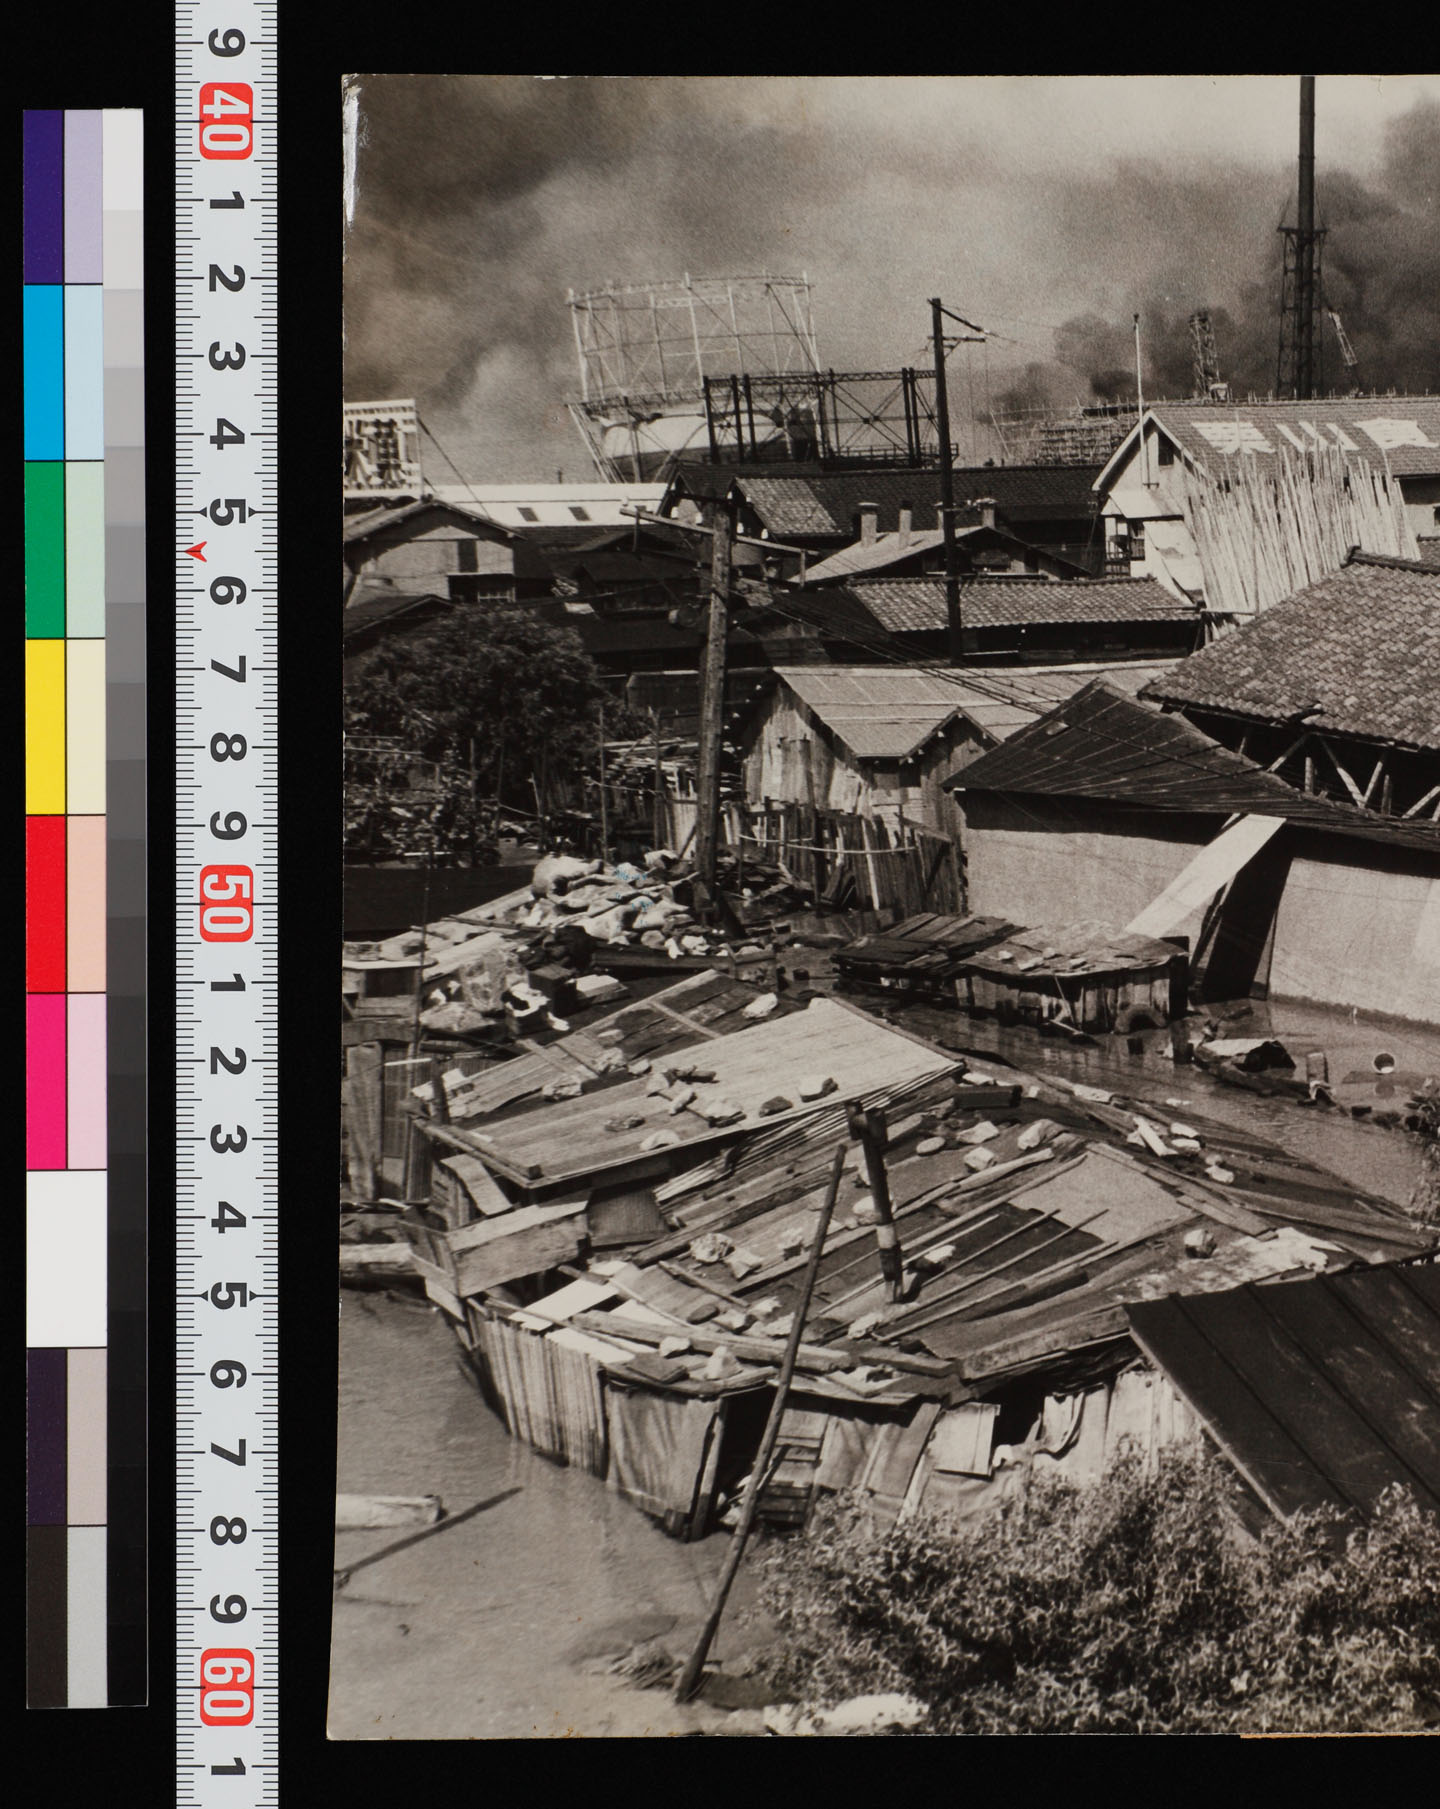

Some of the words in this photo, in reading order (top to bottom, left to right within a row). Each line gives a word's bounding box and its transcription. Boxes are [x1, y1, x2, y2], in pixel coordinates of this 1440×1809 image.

[208, 28, 246, 58] 9
[202, 89, 251, 152] 40
[209, 191, 245, 210] 1
[209, 263, 246, 293] 2
[208, 341, 246, 371] 3
[209, 418, 245, 451] 4
[209, 498, 246, 527] 5
[209, 575, 247, 606] 6
[210, 655, 247, 683] 7
[210, 732, 248, 763] 8
[209, 811, 248, 841] 9
[202, 873, 251, 934] 50
[210, 973, 246, 992] 1
[210, 1046, 247, 1075] 2
[210, 1124, 248, 1154] 3
[211, 1201, 247, 1234] 4
[210, 1281, 248, 1310] 5
[209, 1359, 247, 1389] 6
[210, 1438, 247, 1467] 7
[210, 1515, 247, 1546] 8
[209, 1594, 248, 1624] 9
[202, 1656, 253, 1718] 60
[211, 1757, 246, 1776] 1
